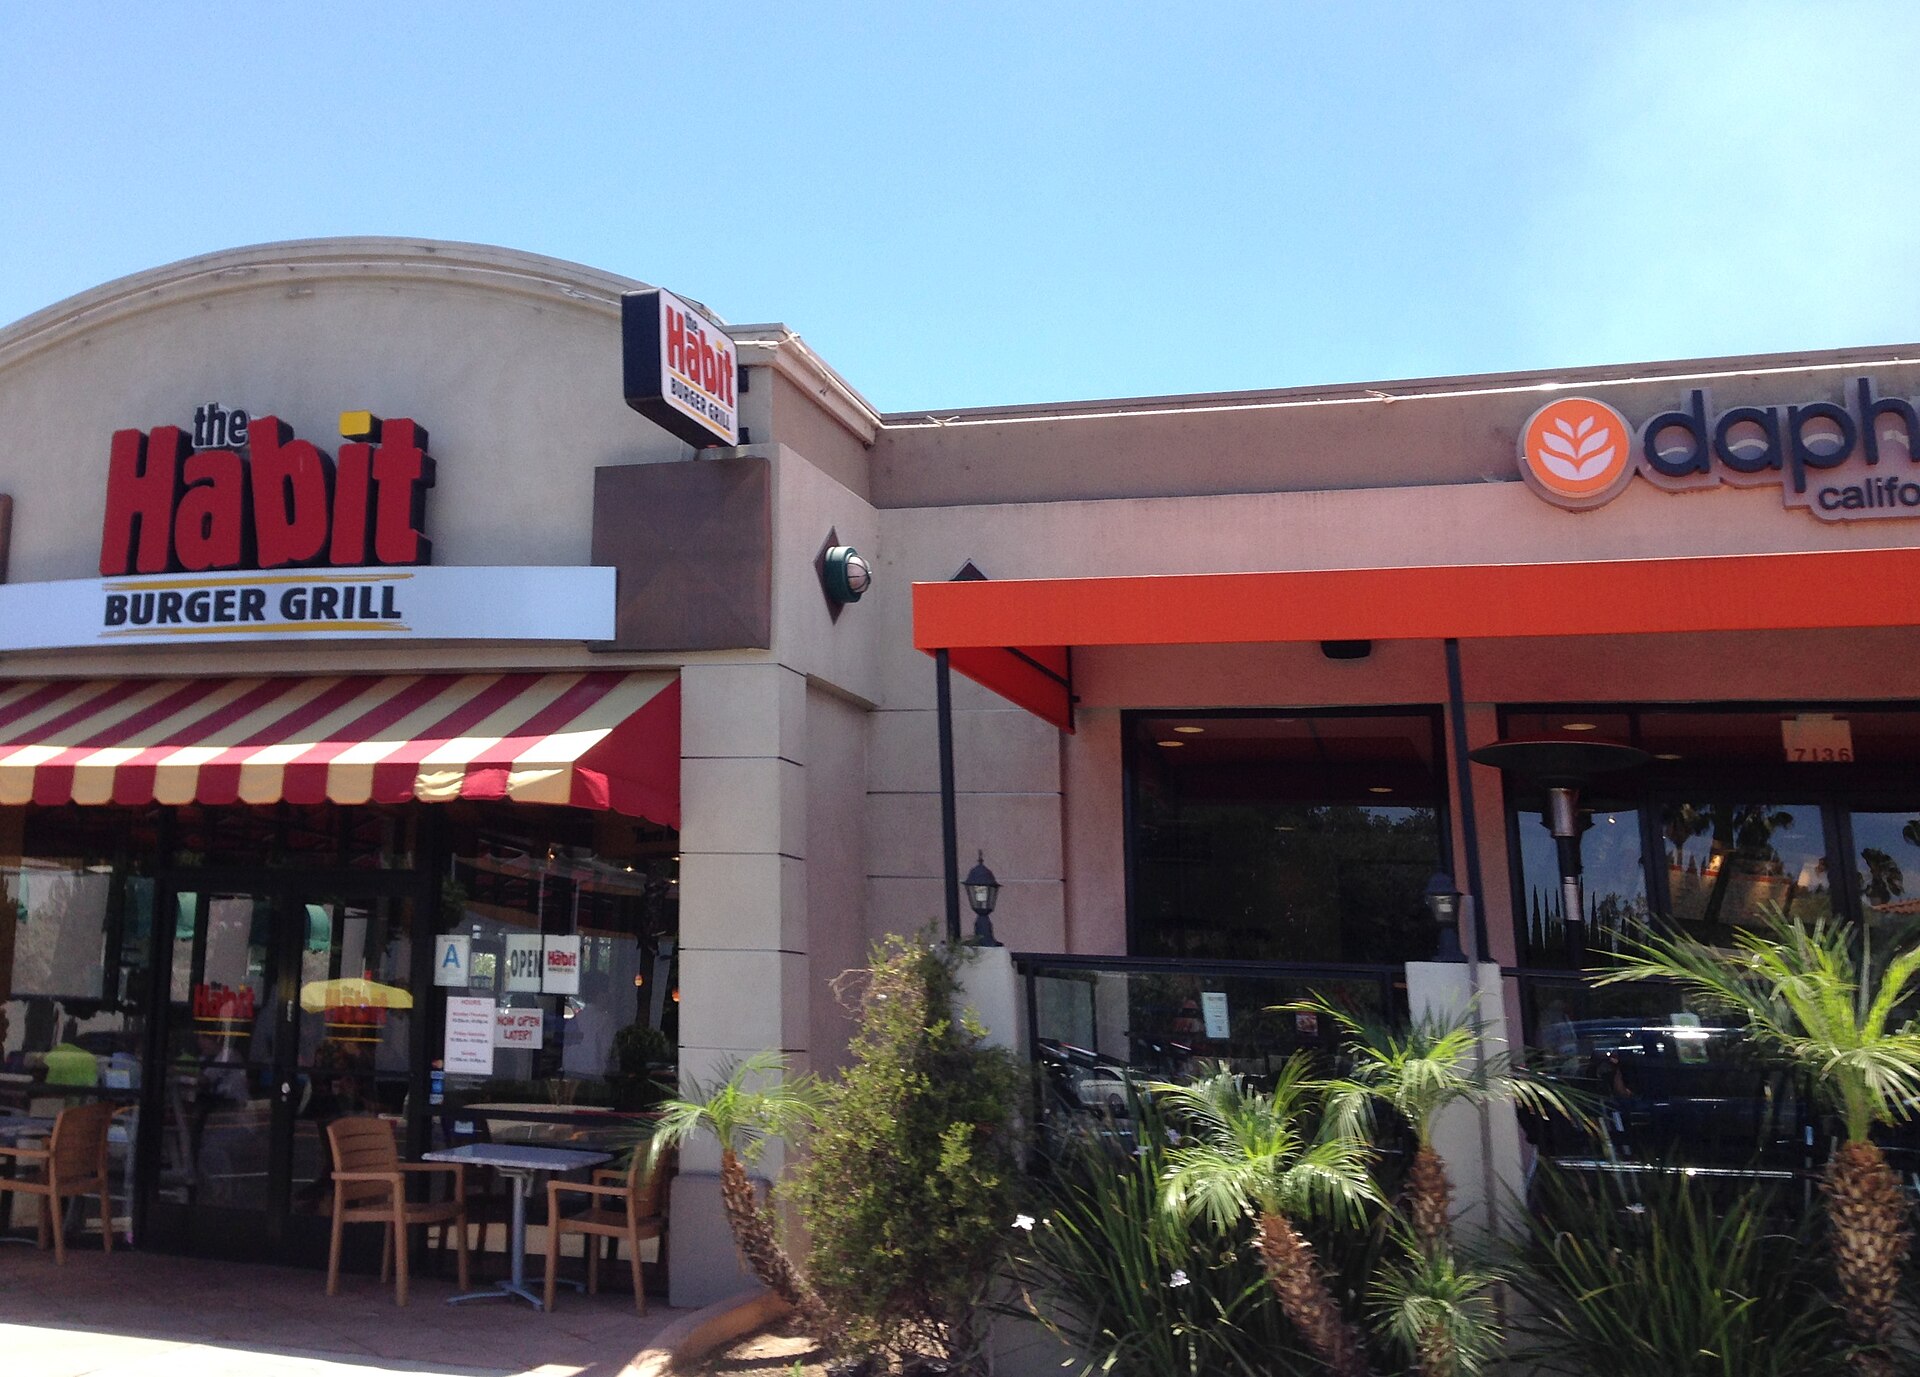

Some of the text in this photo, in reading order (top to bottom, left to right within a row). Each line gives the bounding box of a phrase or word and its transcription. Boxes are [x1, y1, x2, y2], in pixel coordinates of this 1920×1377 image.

[666, 304, 734, 409] Habit
[193, 403, 250, 447] the
[670, 377, 731, 431] BURGER GRILL
[100, 411, 434, 576] Habit
[105, 586, 402, 627] BURGER GRILL
[442, 943, 461, 968] A
[547, 950, 576, 966] Habit
[517, 1015, 541, 1027] OPEN
